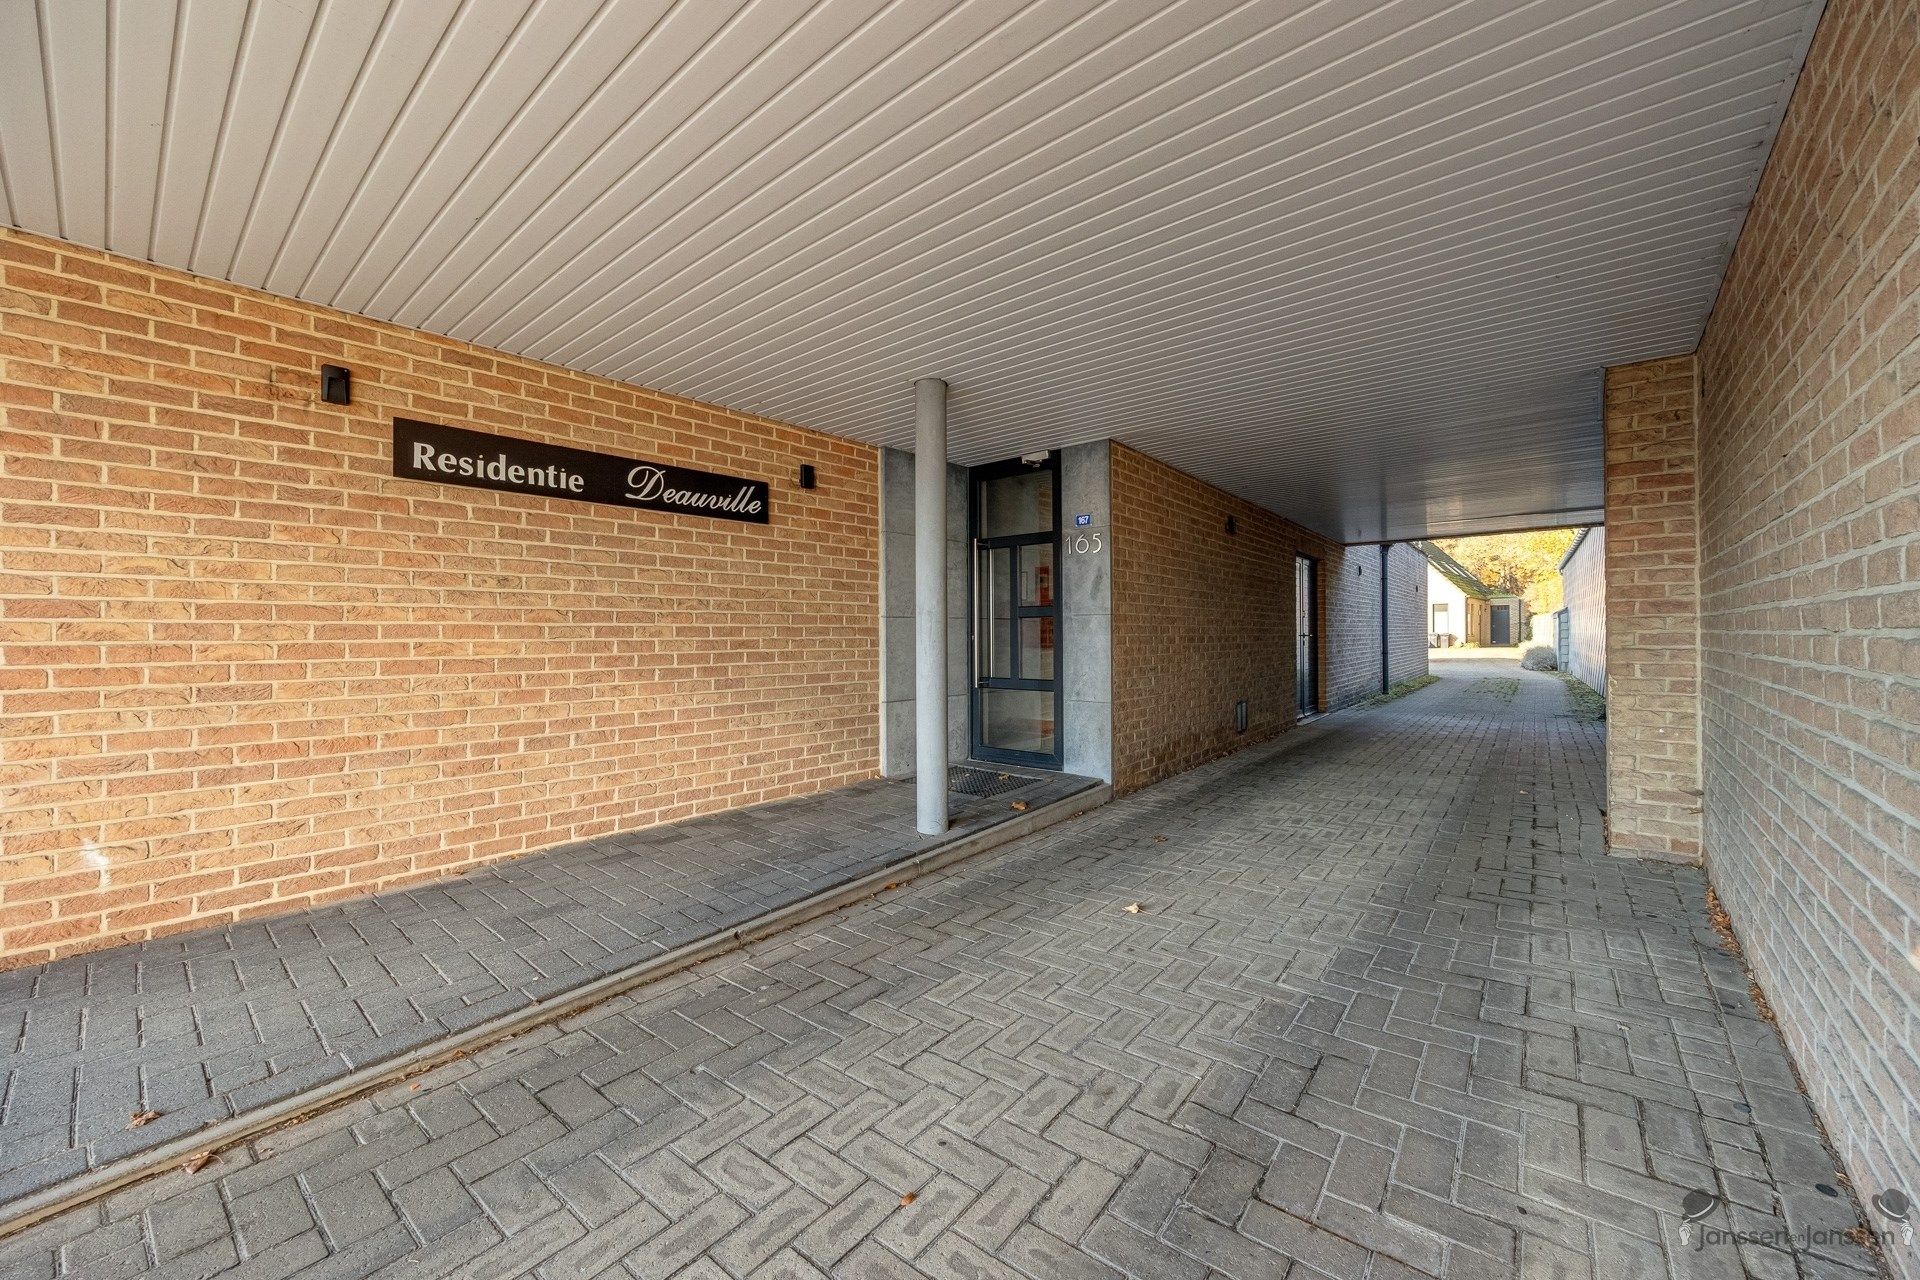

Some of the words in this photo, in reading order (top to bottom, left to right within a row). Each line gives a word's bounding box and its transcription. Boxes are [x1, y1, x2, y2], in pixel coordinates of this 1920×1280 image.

[412, 441, 585, 492] Residentie
[625, 465, 762, 514] Deauville
[1078, 515, 1090, 525] 167
[1065, 532, 1102, 554] 165
